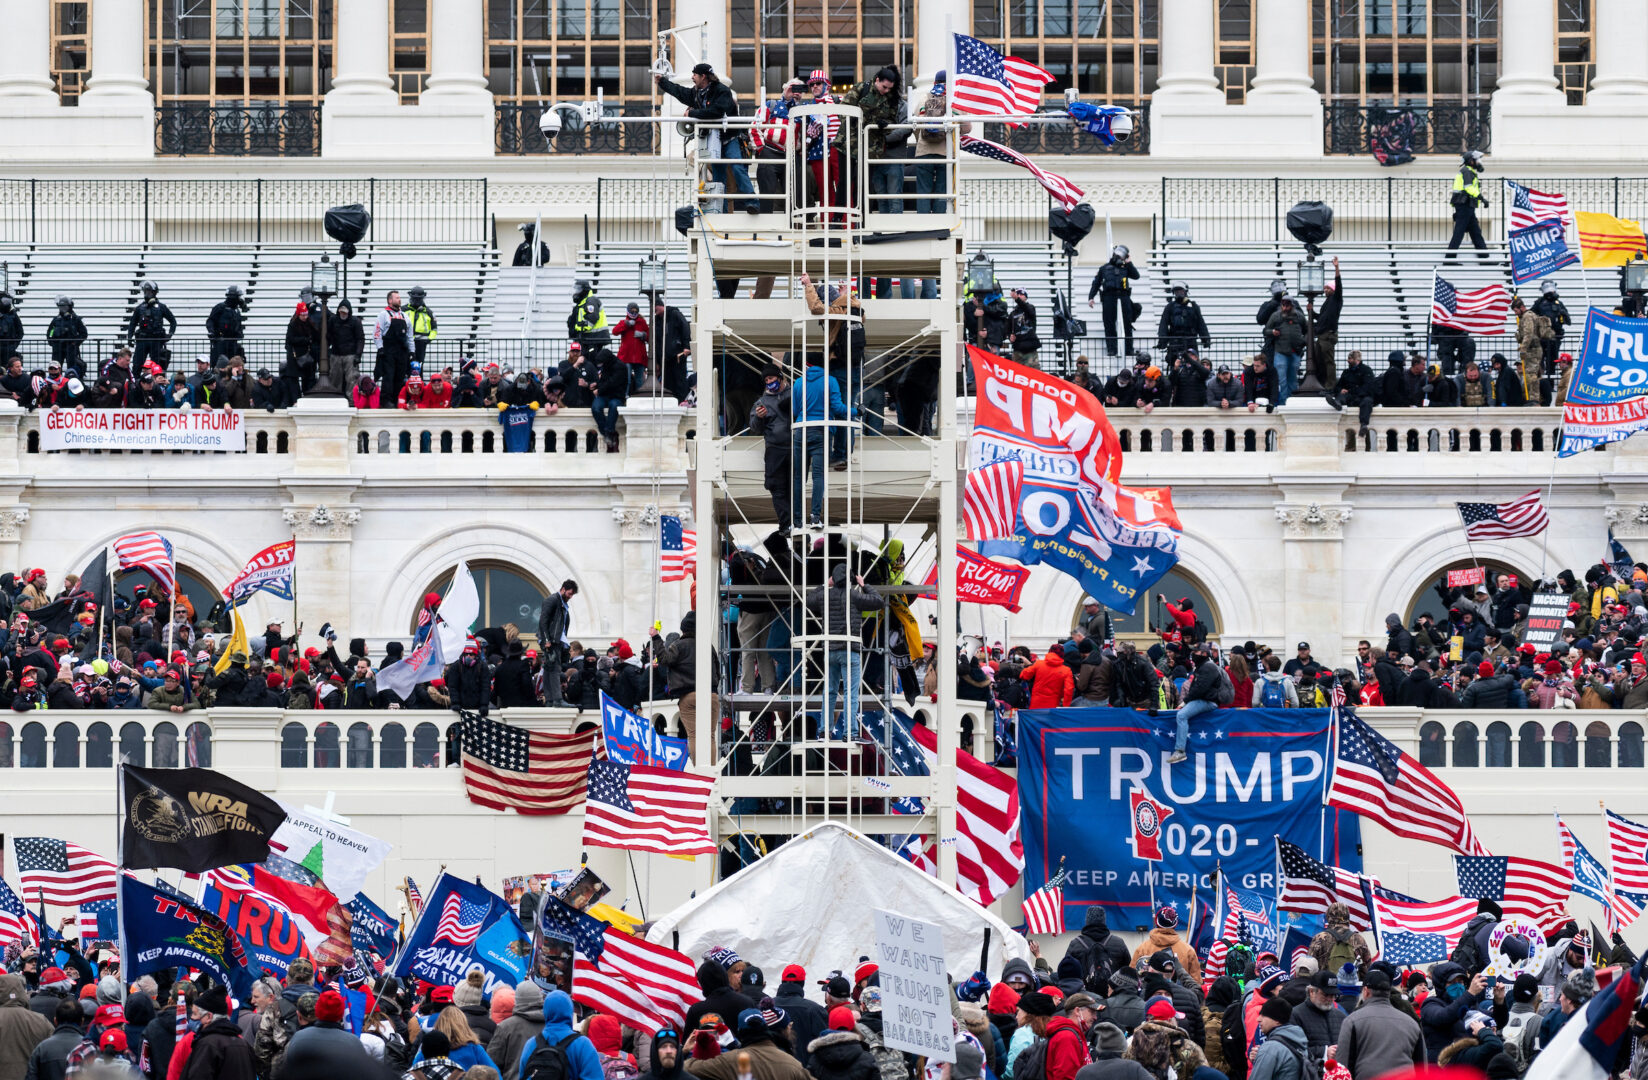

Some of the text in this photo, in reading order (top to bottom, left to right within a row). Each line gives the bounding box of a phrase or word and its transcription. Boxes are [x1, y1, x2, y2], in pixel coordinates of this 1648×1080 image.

[1508, 227, 1561, 254] TRUMP
[1525, 248, 1556, 263] -2020-
[1594, 322, 1648, 362] TRU
[1597, 365, 1648, 387] 20
[1578, 383, 1606, 398] KEEP
[47, 412, 240, 430] GEORGIA FIGHT FOR TRUMP
[64, 432, 222, 445] Chinese-American Republicans
[957, 582, 992, 598] -2020-
[1533, 594, 1570, 606] VACCINE
[1528, 607, 1568, 618] MANDATES
[1528, 619, 1562, 630] VIOLATE
[1525, 631, 1557, 642] BODILY
[867, 777, 891, 788] TRUMP
[1054, 746, 1324, 805] TRUMP
[188, 791, 249, 819] NRA
[293, 819, 323, 836] APPEAL
[326, 830, 336, 841] TO
[337, 835, 369, 854] HEAVEN
[1126, 823, 1259, 857] -020-
[1064, 869, 1288, 889] KEEP AMERIC GRE
[885, 915, 925, 943] WE
[137, 946, 163, 963] KEEP
[164, 945, 220, 973] AMERICA
[881, 942, 944, 975] WANT
[879, 971, 944, 1006] TRUMP
[898, 1004, 937, 1030] NOT
[883, 1020, 950, 1053] BARABBAS
